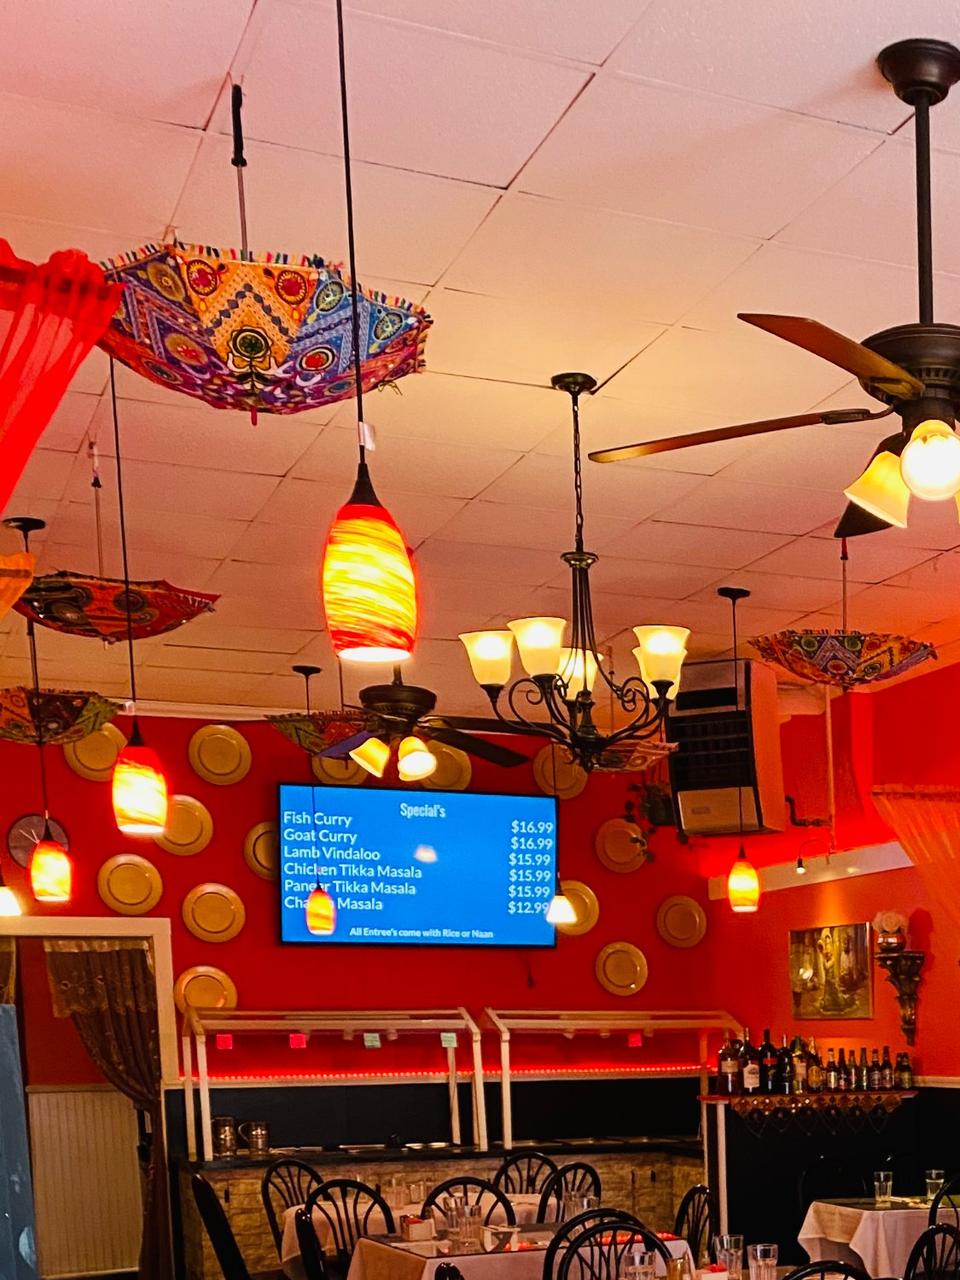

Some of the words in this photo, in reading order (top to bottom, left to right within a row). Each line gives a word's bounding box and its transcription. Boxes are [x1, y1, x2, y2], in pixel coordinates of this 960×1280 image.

[400, 803, 446, 819] Special's
[283, 811, 311, 824] Fish
[314, 812, 352, 828] Curry
[511, 820, 553, 834] $16.99
[283, 828, 316, 841] Goat
[319, 830, 357, 845] Curry
[511, 836, 553, 850] $16.99
[284, 846, 320, 858] Lamb
[322, 847, 380, 860] Vindaloo
[509, 852, 551, 866] $15.99
[339, 864, 375, 877] Tikka
[377, 865, 422, 878] Masala
[509, 868, 551, 882] $15.99
[332, 880, 368, 893] Tikka
[371, 881, 416, 895] Masala
[508, 884, 550, 899] $15.99
[337, 897, 383, 910] Masala
[508, 900, 550, 915] $12.99
[349, 927, 362, 937] All
[363, 928, 398, 937] Entree's
[422, 929, 441, 938] with
[442, 929, 460, 938] Rice
[472, 930, 494, 939] Naan
